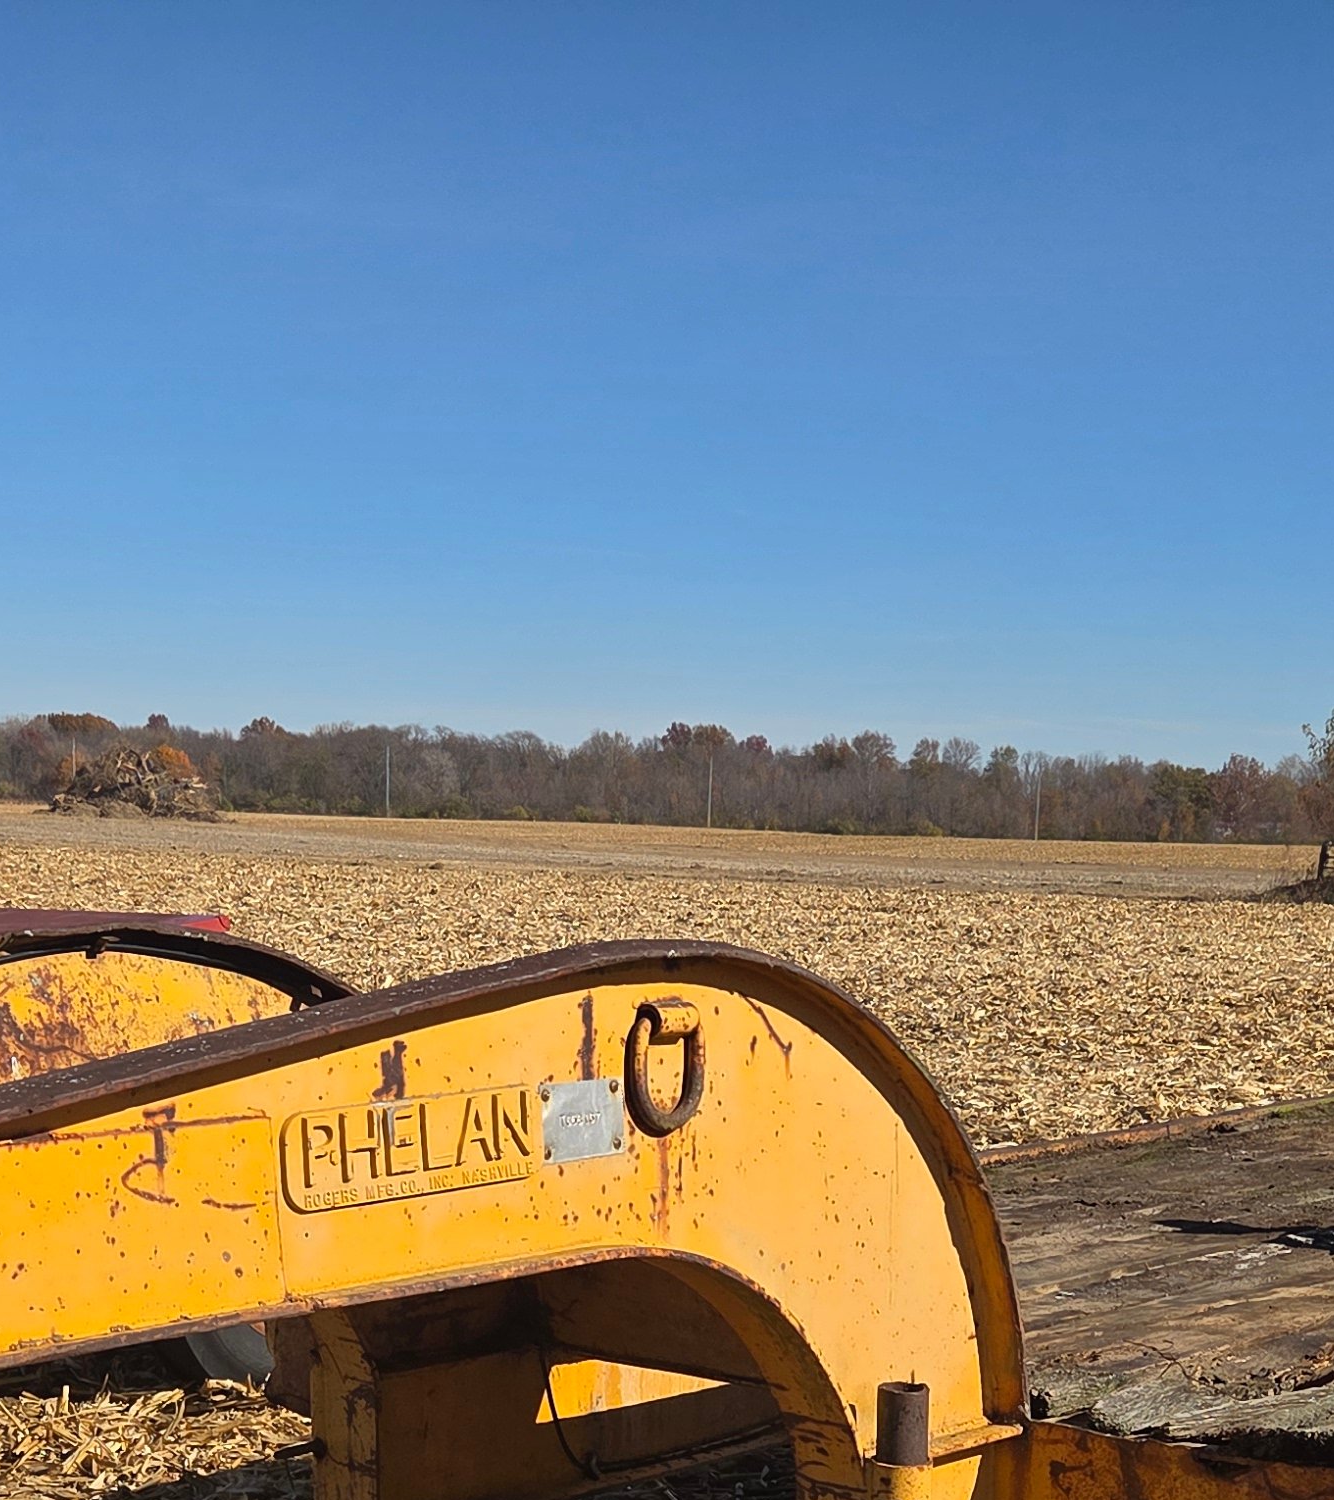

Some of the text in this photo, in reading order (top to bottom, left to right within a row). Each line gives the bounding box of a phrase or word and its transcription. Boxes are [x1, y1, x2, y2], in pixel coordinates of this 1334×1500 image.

[301, 1089, 531, 1188] PHELAN
[304, 1188, 358, 1208] ROGERS
[462, 1161, 534, 1185] NASHVILLE
